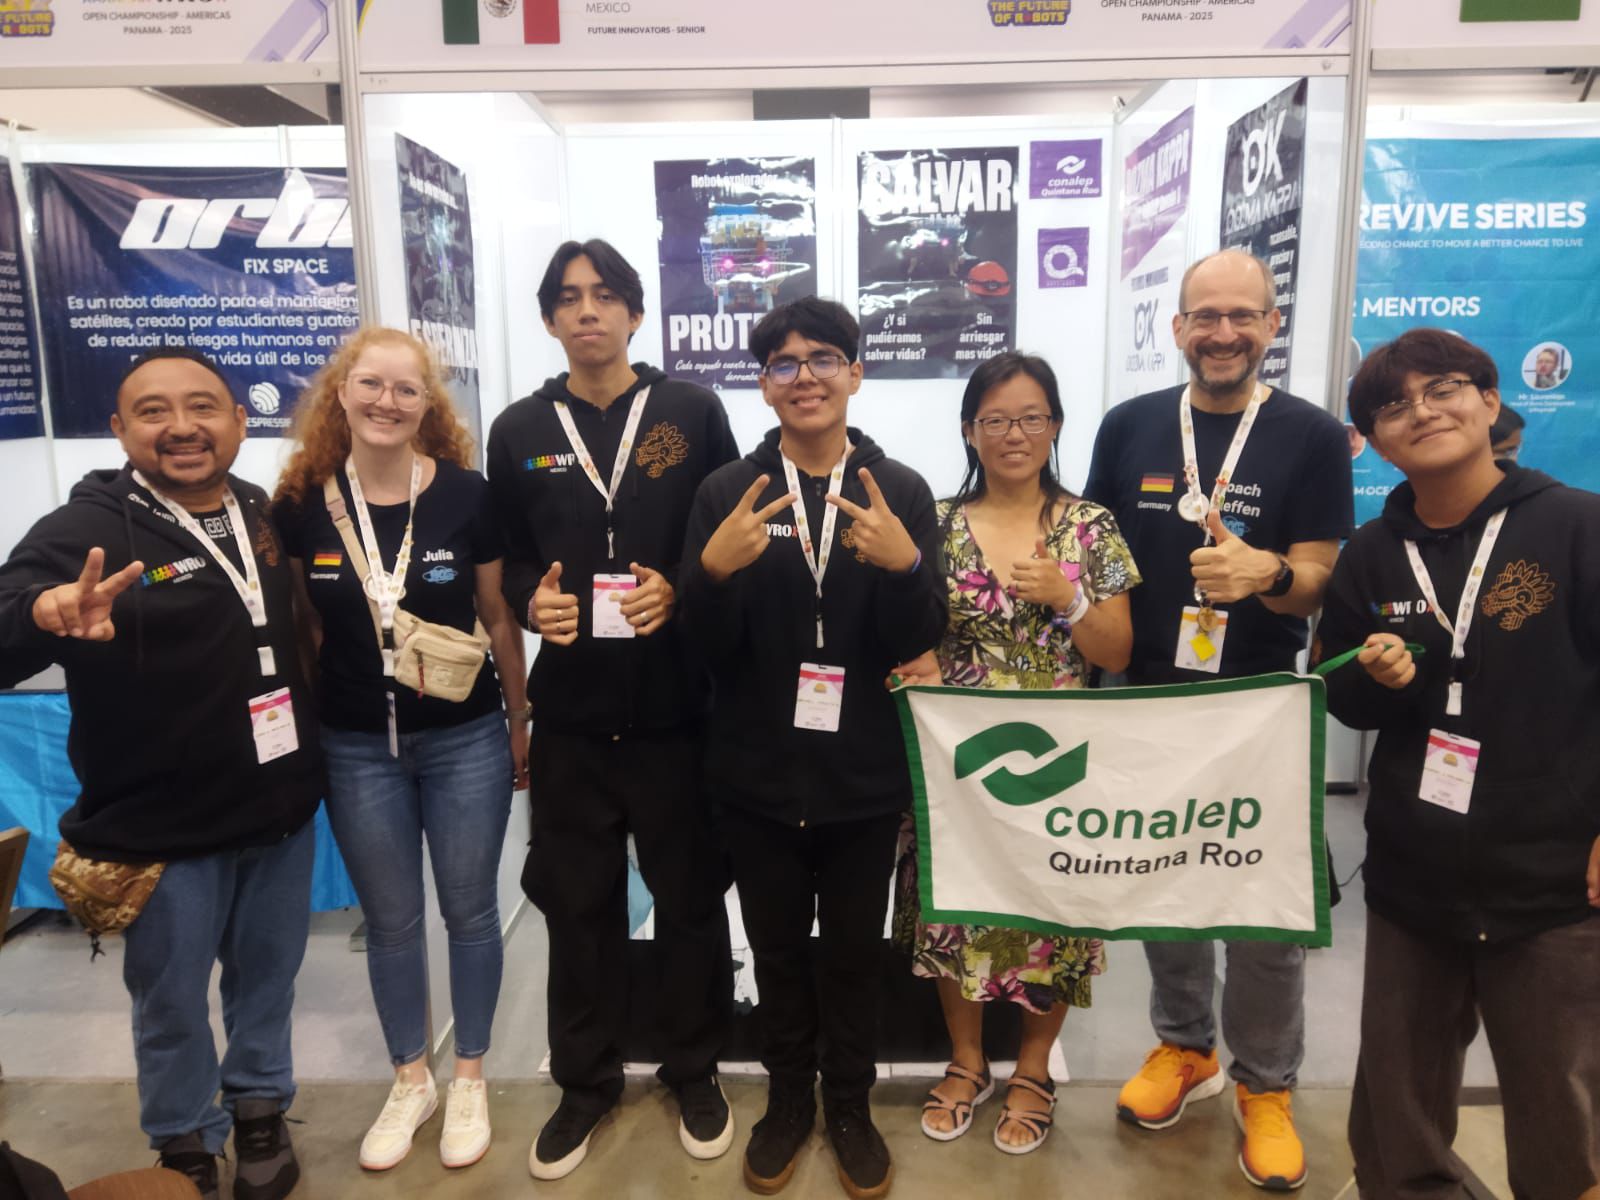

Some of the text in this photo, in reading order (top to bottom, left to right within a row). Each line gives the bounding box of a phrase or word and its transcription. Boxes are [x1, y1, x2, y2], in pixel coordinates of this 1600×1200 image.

[585, 2, 631, 13] MEXICO
[82, 12, 108, 21] OPEN
[109, 11, 179, 21] CHAMPIONSHIP
[186, 11, 231, 20] AMERICAS
[995, 13, 1011, 24] OF
[1141, 13, 1183, 21] PANAMA
[1189, 12, 1213, 21] 2025
[123, 26, 163, 35] PANAMA
[169, 26, 192, 35] 2025
[587, 26, 617, 34] FUTURE
[618, 26, 671, 34] INNOVATORS
[676, 26, 705, 34] SENIOR
[691, 174, 721, 189] Robot
[860, 159, 1013, 215] SALVAR
[1048, 176, 1094, 188] conalep
[1041, 187, 1081, 197] Quintana
[1359, 202, 1586, 231] REVIVE SERIES
[1359, 238, 1584, 249] ECOND CHANCE TO MOVE A BETTER CHANCE TO LIVE
[244, 258, 329, 274] FIX SPACE
[67, 296, 84, 310] Es
[87, 299, 107, 309] un
[110, 296, 148, 309] robot
[150, 294, 217, 308] diseñado
[221, 297, 256, 311] para
[258, 295, 274, 307] el
[1362, 296, 1481, 318] MENTORS
[70, 313, 360, 331] satélites, creado por estudiantes guatem
[883, 314, 906, 328] ¿Y si
[976, 313, 993, 325] Sin
[670, 313, 763, 351] PROT
[866, 331, 922, 345] pudiéramos
[959, 331, 1005, 345] arriesgar
[88, 334, 108, 347] de
[111, 333, 161, 347] reducir
[165, 333, 186, 347] los
[187, 333, 239, 351] riesgos
[242, 332, 313, 346] humanos
[317, 335, 337, 346] en
[220, 351, 252, 365] vida
[255, 351, 277, 365] útil
[281, 351, 301, 365] de
[304, 351, 326, 365] los
[865, 347, 926, 361] salvar vidas?
[955, 350, 975, 360] mas
[1226, 483, 1262, 498] oach
[1137, 501, 1173, 513] Germany
[1221, 500, 1262, 518] effen
[422, 549, 454, 562] Julia
[173, 557, 206, 574] WRO
[310, 572, 340, 581] Germany
[1044, 796, 1262, 840] conalep
[1048, 842, 1263, 875] Quintana Roo
